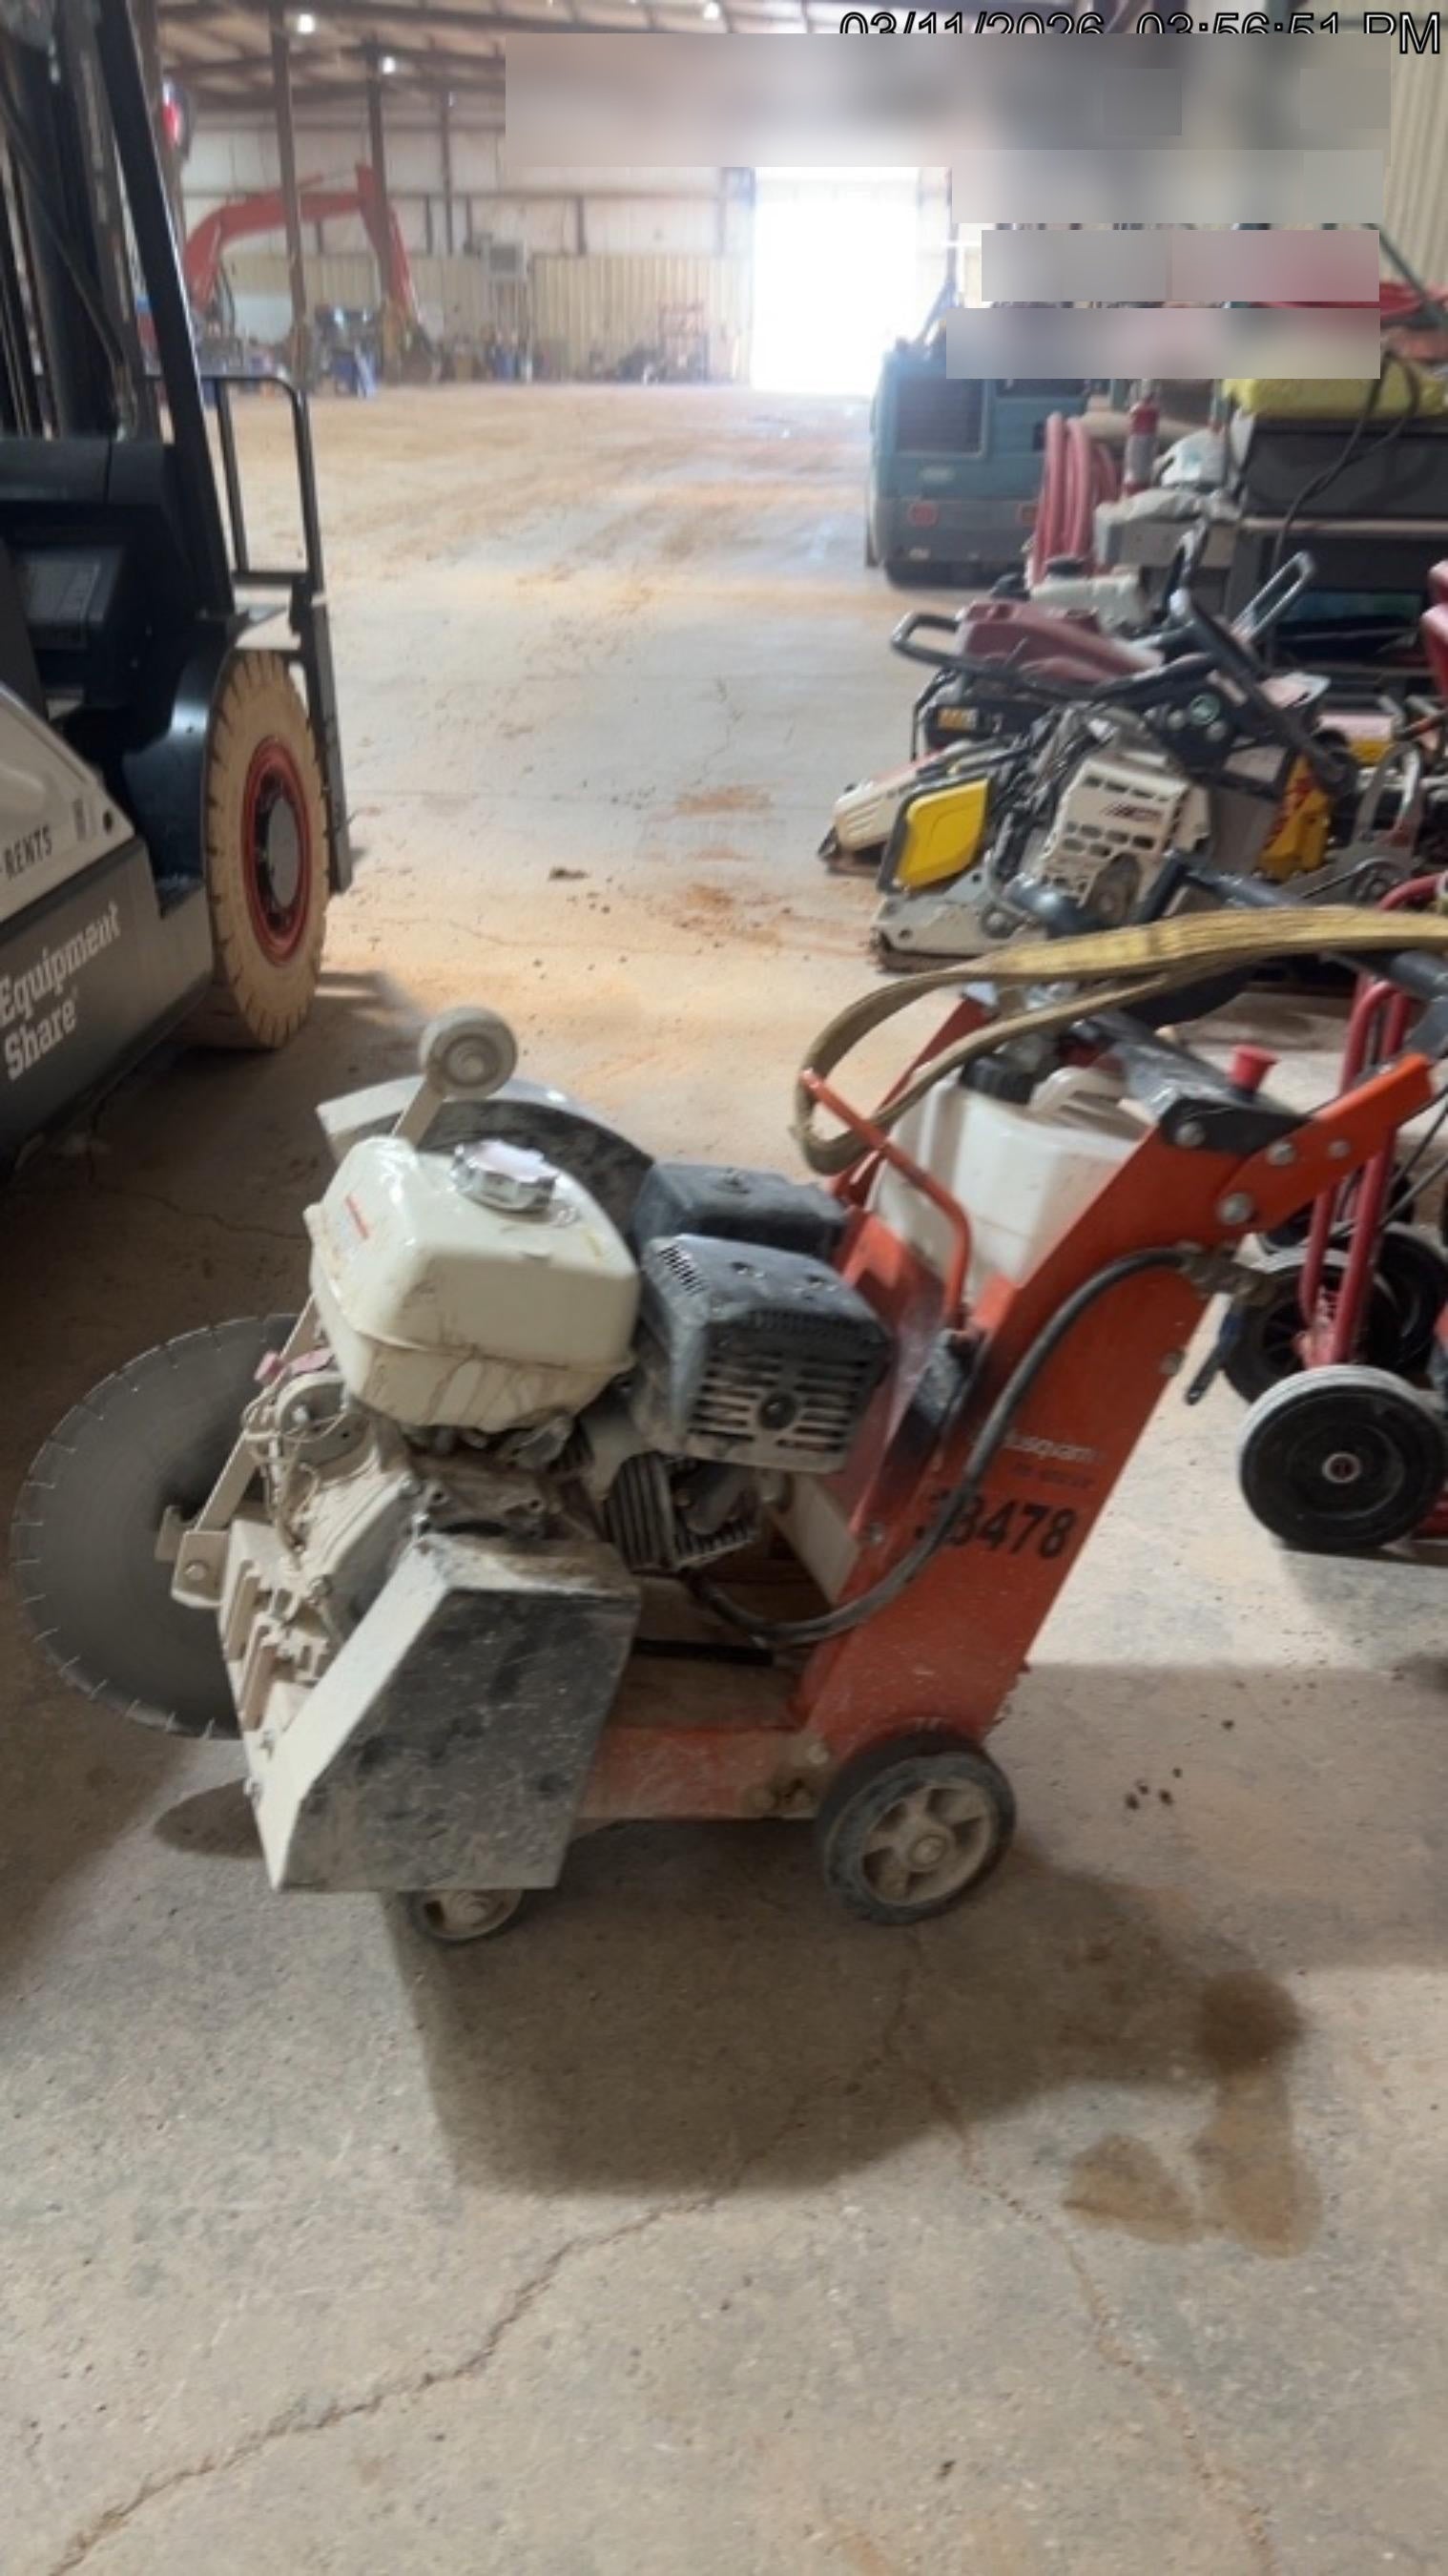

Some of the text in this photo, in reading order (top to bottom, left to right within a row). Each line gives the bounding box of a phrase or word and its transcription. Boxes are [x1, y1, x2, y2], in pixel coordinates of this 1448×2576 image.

[4, 822, 52, 881] RENTS
[0, 900, 121, 1027] Equipment
[5, 998, 77, 1080] Share
